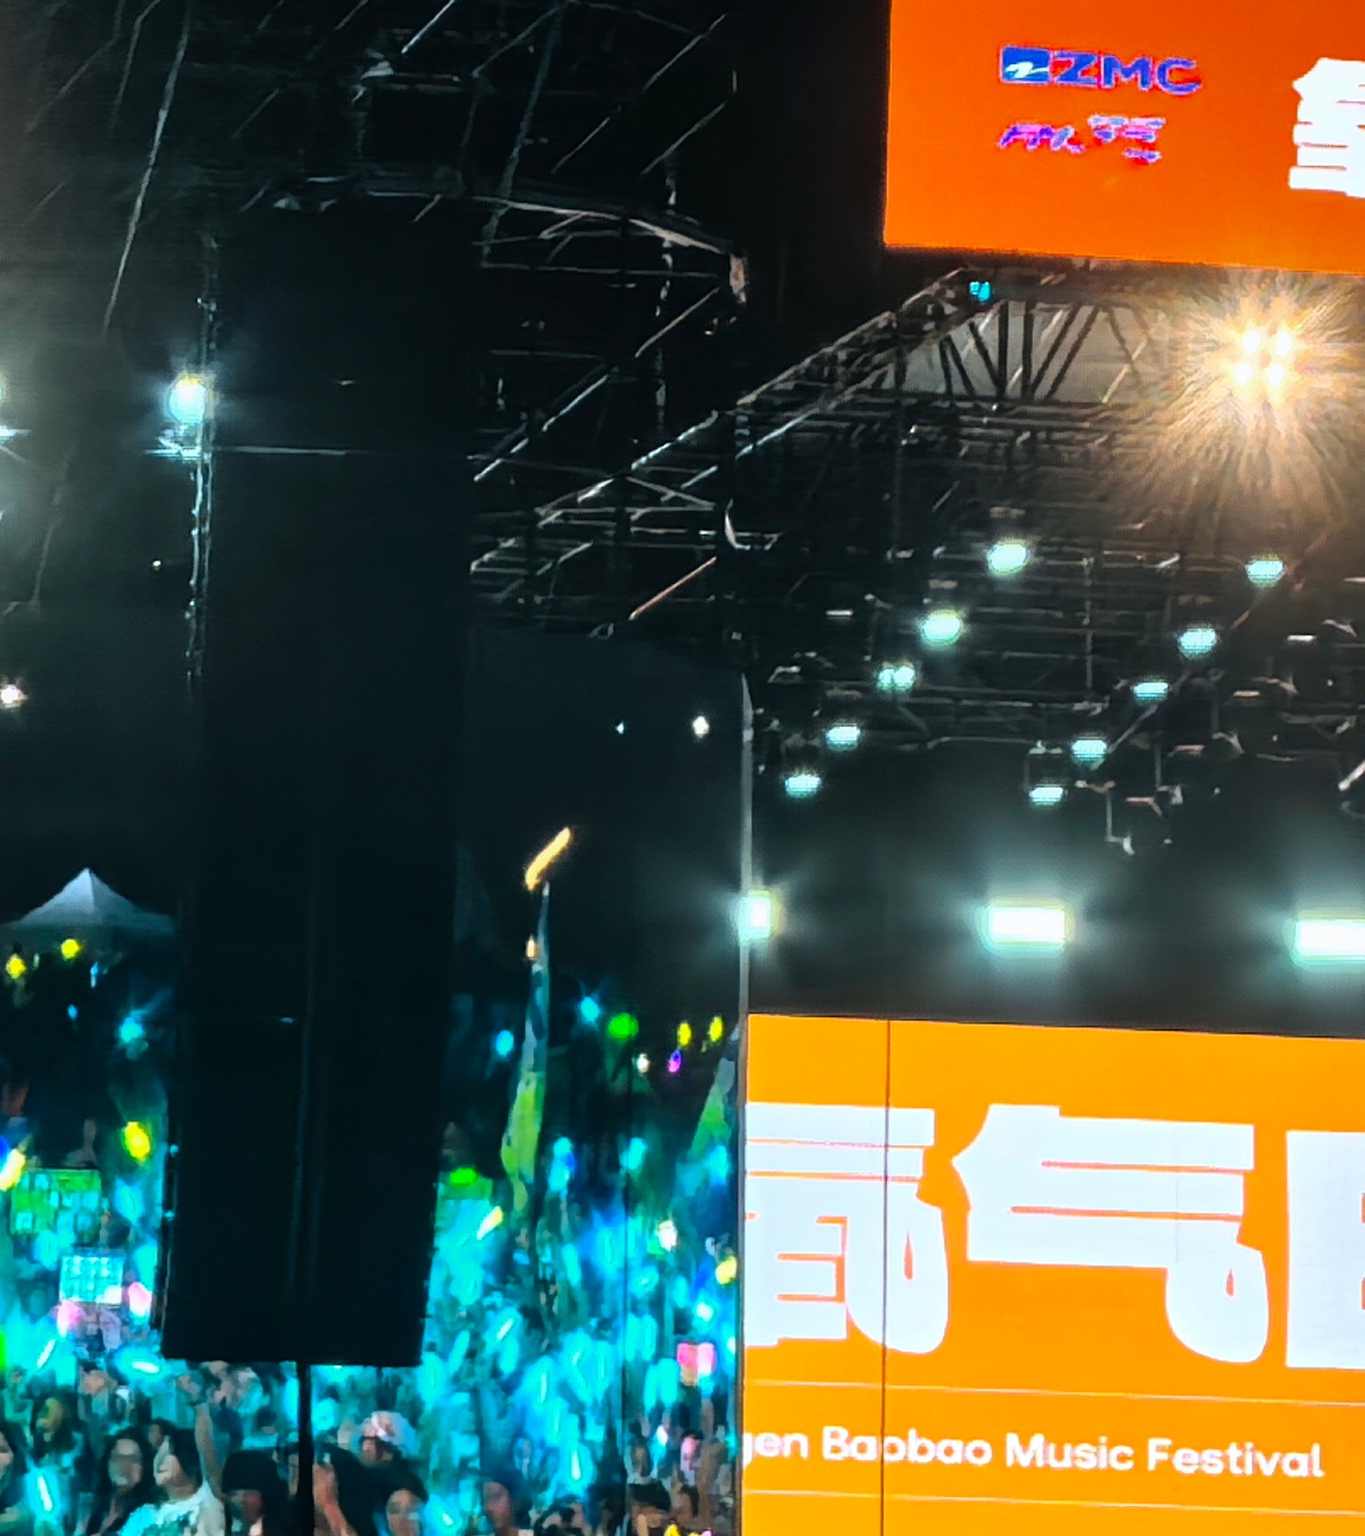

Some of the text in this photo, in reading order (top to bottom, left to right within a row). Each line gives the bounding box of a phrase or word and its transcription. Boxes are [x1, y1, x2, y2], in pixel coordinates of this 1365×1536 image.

[1052, 49, 1203, 95] ZMC
[822, 1425, 992, 1466] Baobao
[1005, 1432, 1134, 1471] Music
[1147, 1437, 1325, 1477] Festival
